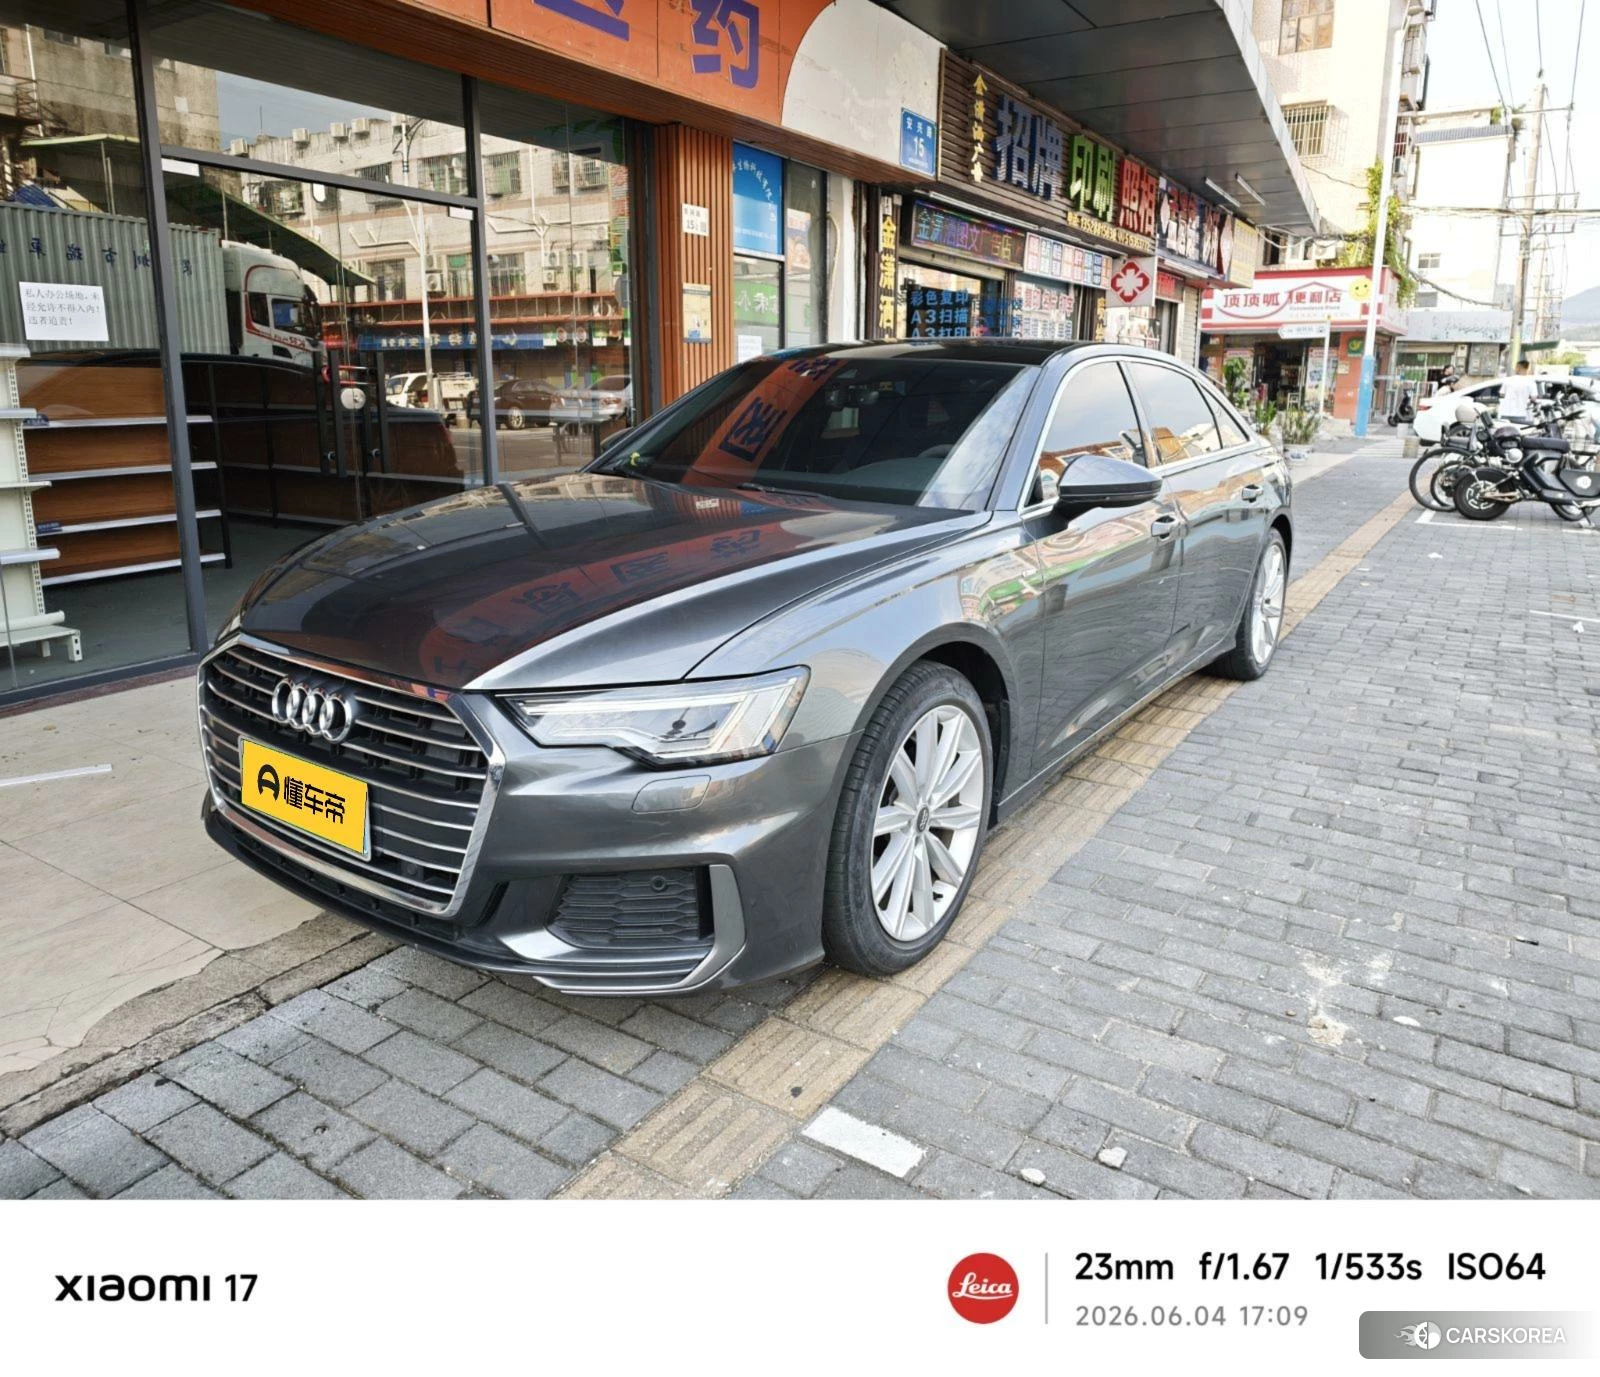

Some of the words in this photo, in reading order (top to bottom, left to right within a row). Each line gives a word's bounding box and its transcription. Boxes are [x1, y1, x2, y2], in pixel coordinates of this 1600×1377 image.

[913, 136, 925, 158] 15
[910, 287, 969, 306] 彩色复印
